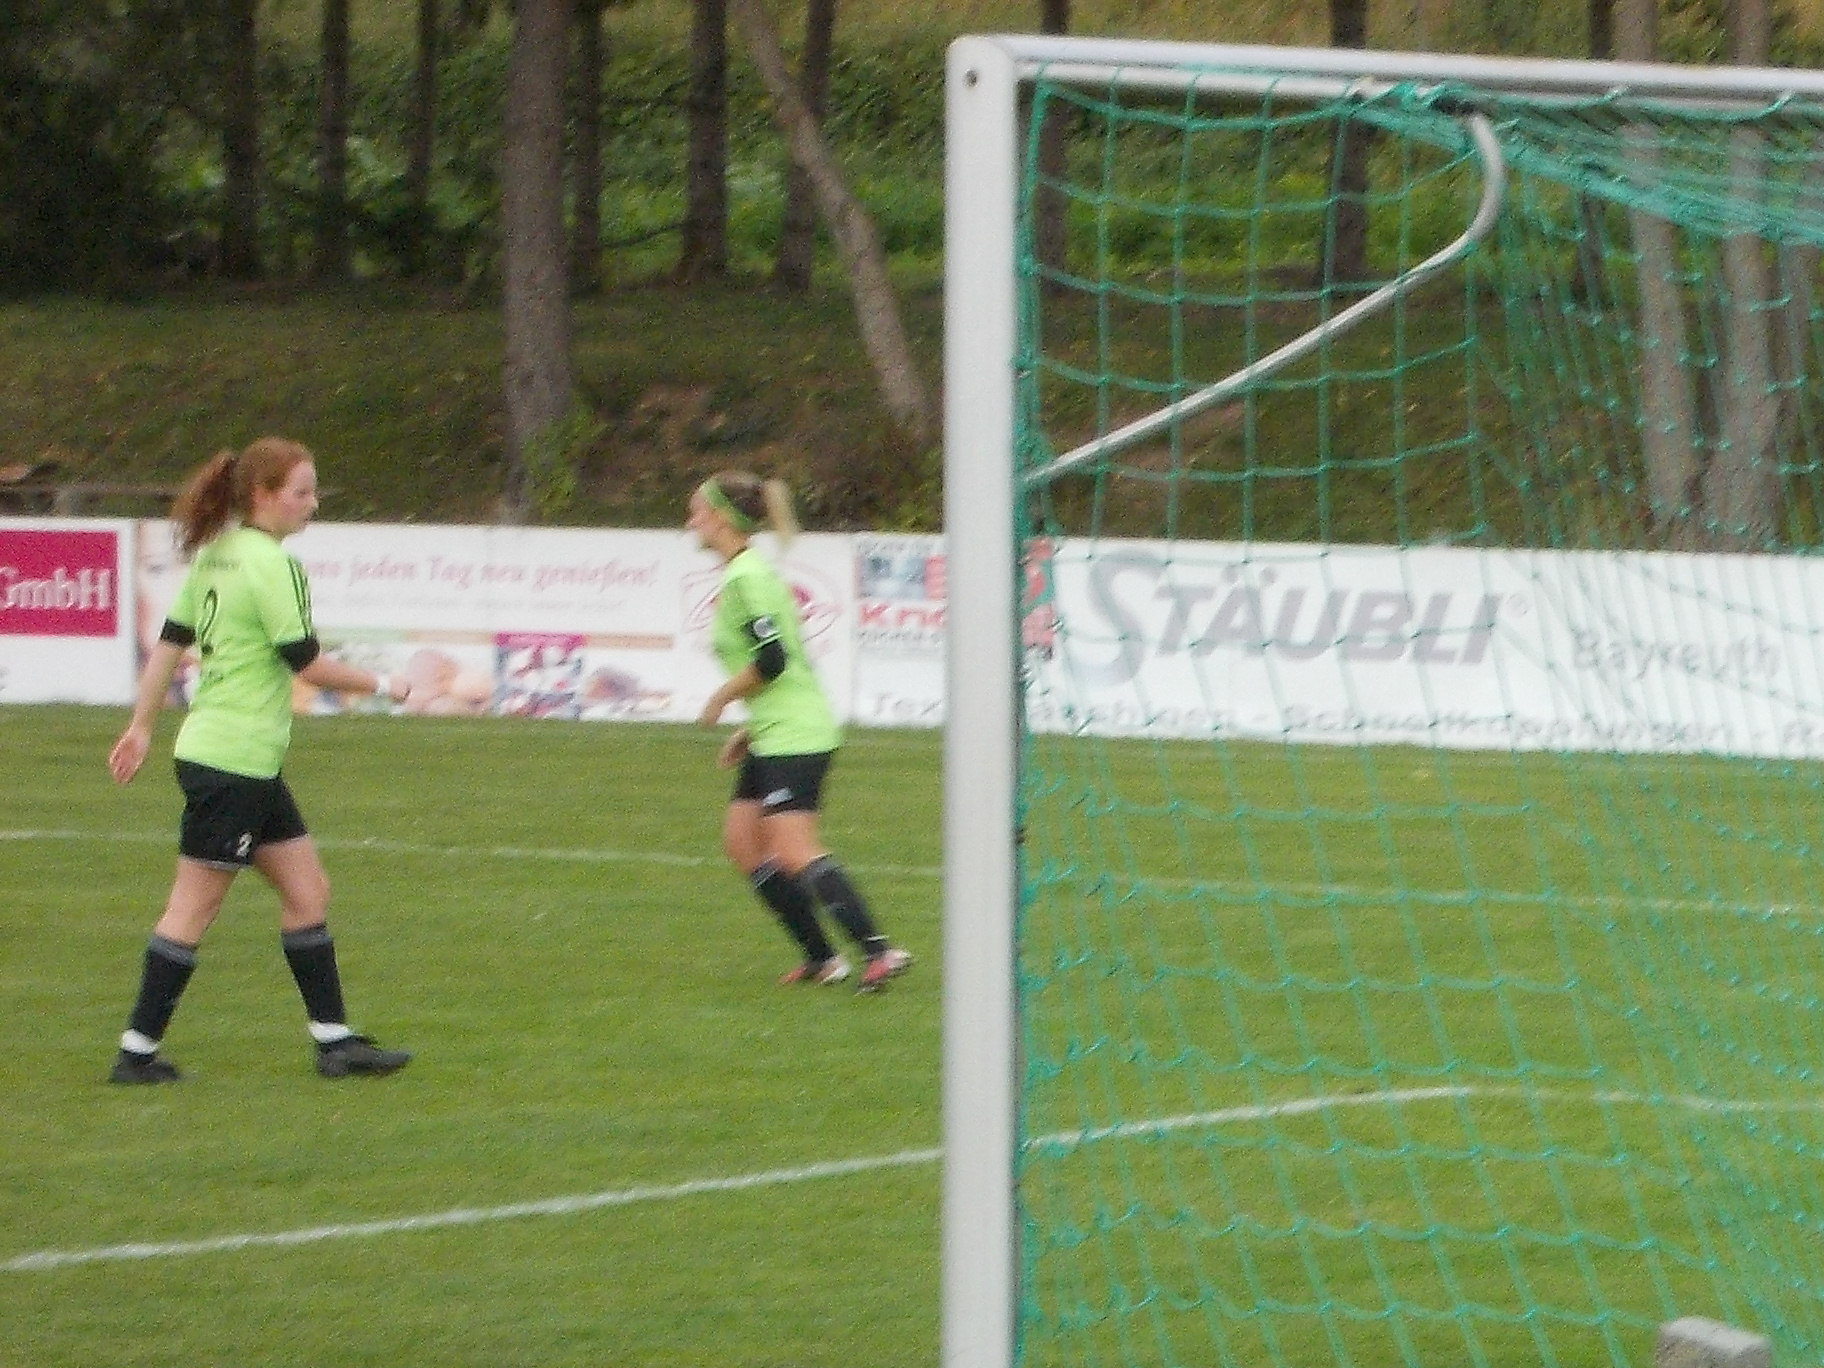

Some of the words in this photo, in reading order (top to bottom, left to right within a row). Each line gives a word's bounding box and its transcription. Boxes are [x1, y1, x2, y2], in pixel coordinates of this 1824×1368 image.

[349, 554, 415, 586] jeden
[429, 556, 473, 590] Tag
[481, 562, 523, 582] neu
[1076, 549, 1499, 687] STÄUBLI
